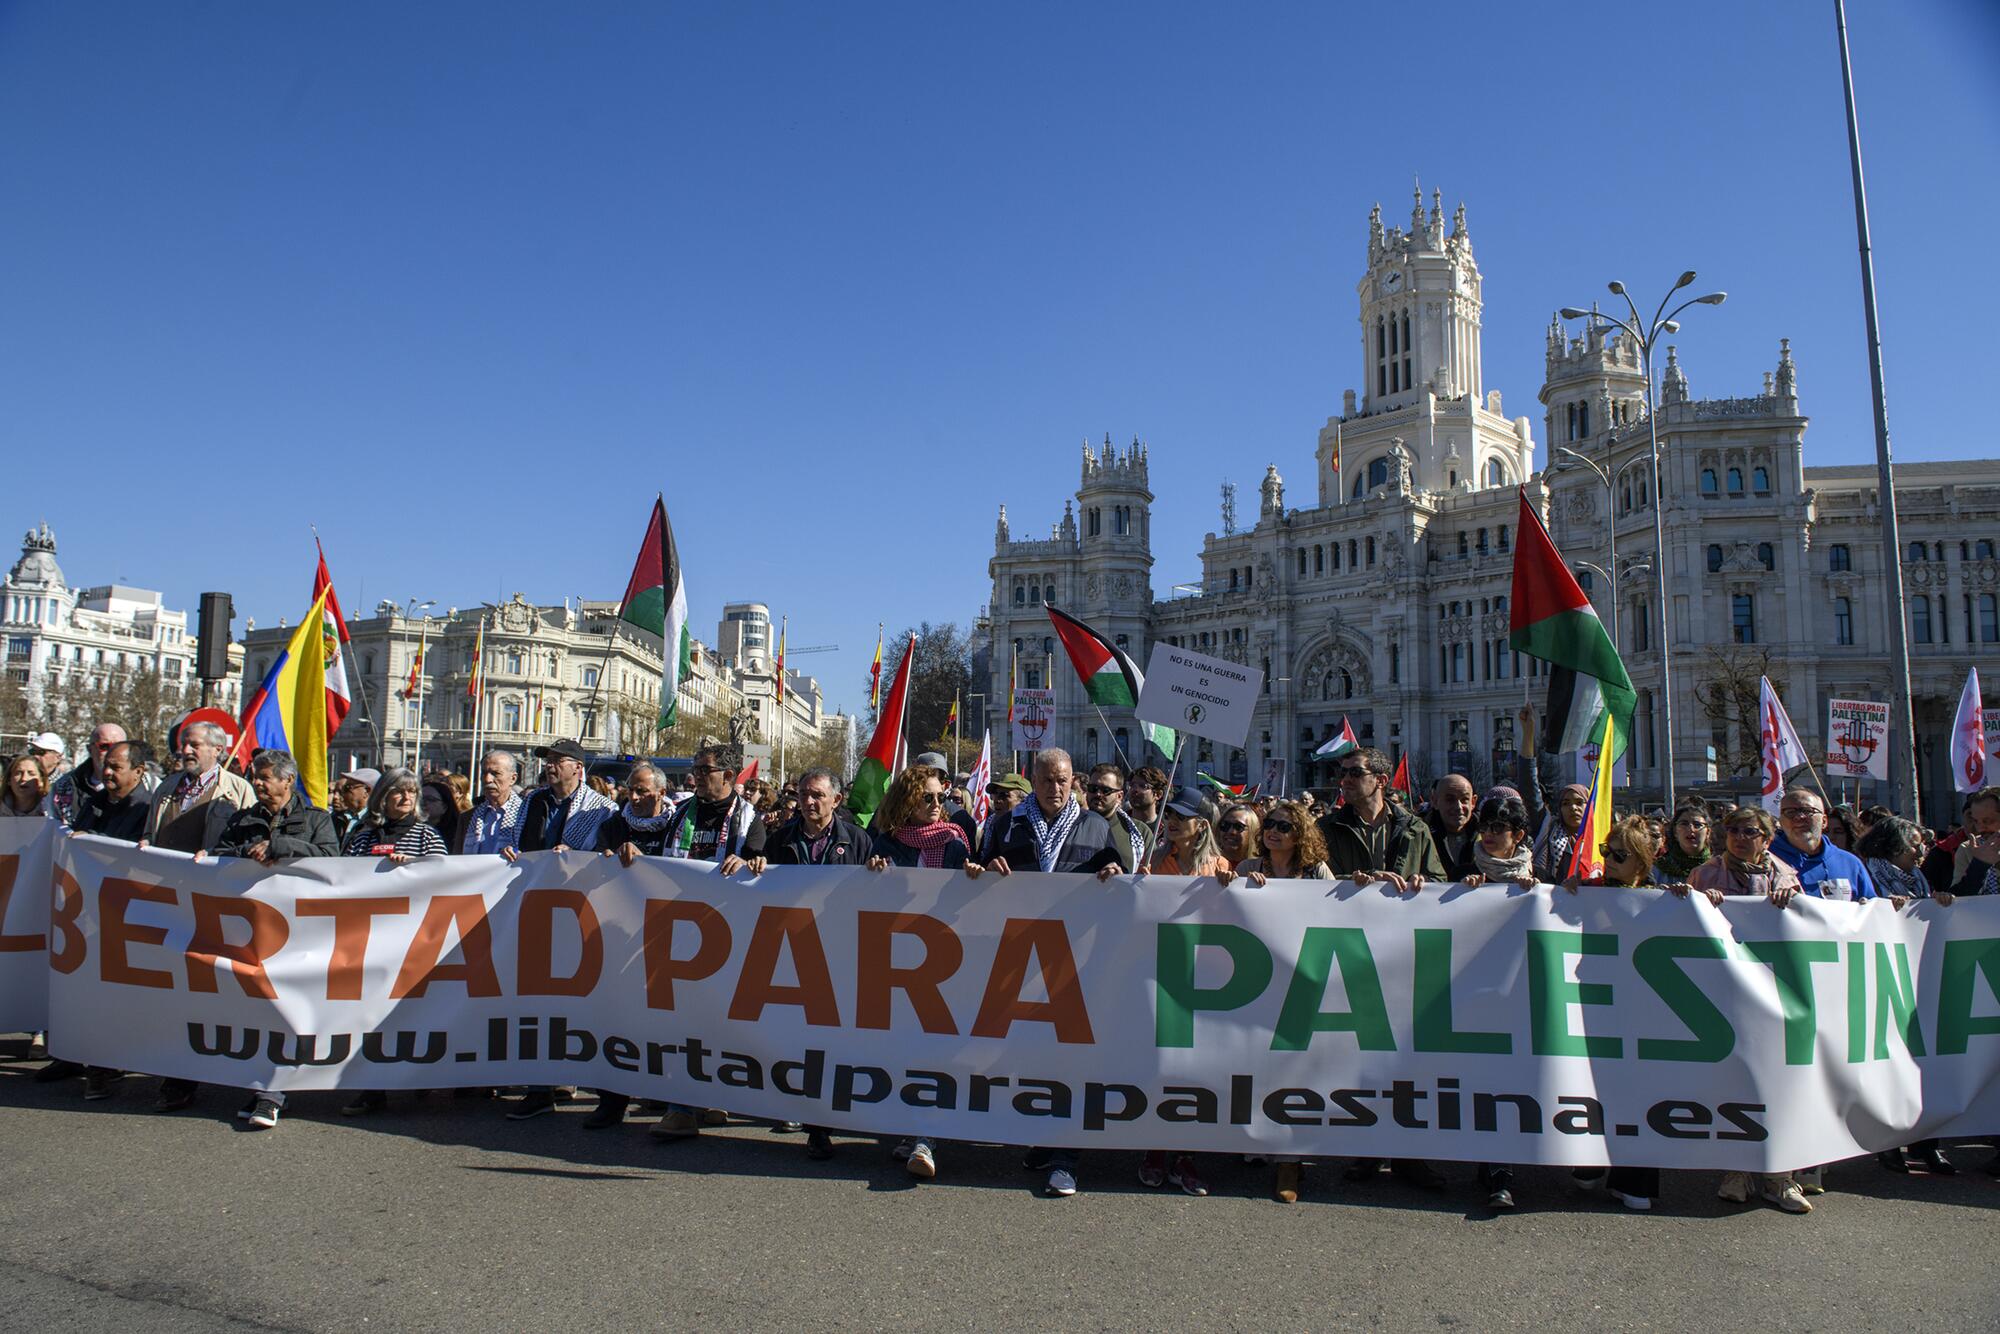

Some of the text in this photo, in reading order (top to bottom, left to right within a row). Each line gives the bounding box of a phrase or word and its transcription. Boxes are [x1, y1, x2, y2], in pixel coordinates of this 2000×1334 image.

[1169, 655, 1247, 683] NO ES UNA GUERRA
[1199, 678, 1209, 686] ES
[1015, 696, 1054, 705] PALESTINA
[1171, 684, 1230, 707] UN GENOCIDIO
[1832, 702, 1886, 712] LIBERTAD PARA
[1832, 709, 1885, 722] PALESTINA
[1847, 764, 1868, 772] USO
[0, 855, 2000, 1066] LBERTAD PARA PALESTINA
[187, 1017, 1769, 1142] www.libertadparapalestina.es
